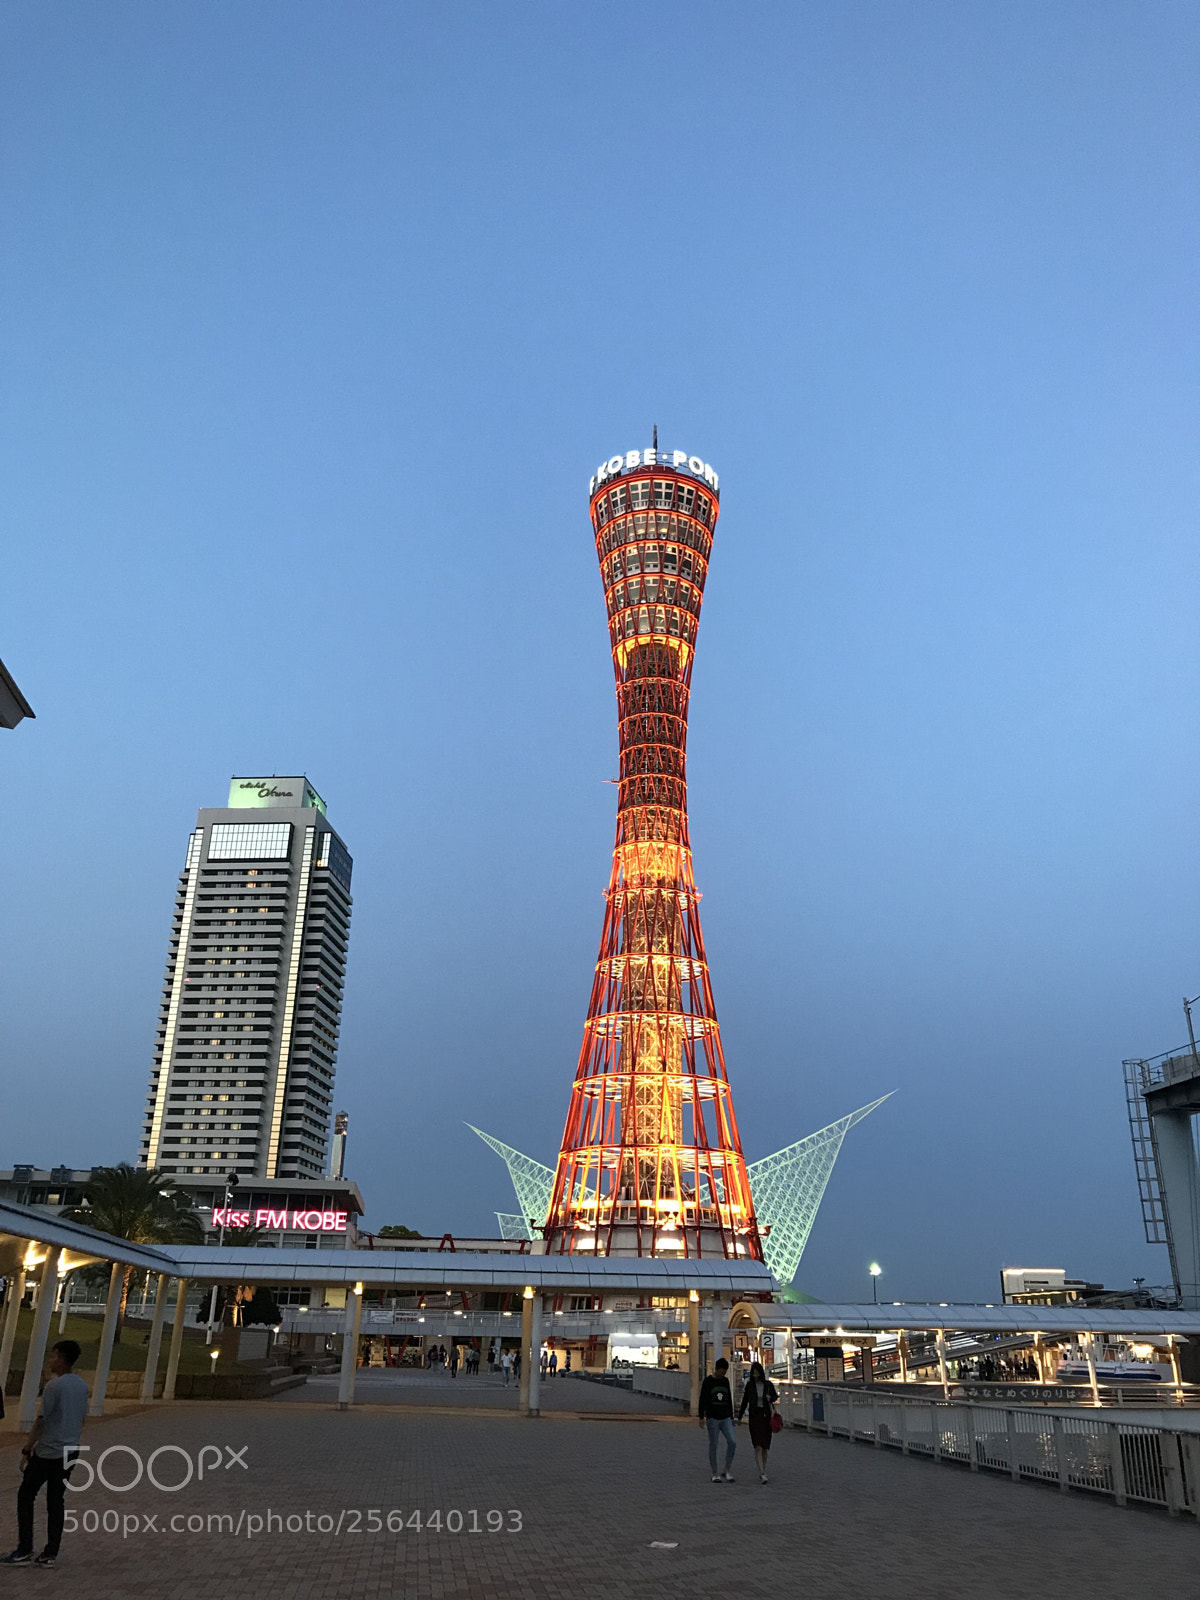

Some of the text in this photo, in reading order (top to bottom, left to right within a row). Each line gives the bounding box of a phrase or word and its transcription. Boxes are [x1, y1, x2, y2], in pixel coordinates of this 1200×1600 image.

[597, 448, 657, 483] KOBE
[212, 1208, 348, 1231] Kiss FM KOBE
[763, 1336, 772, 1346] 2
